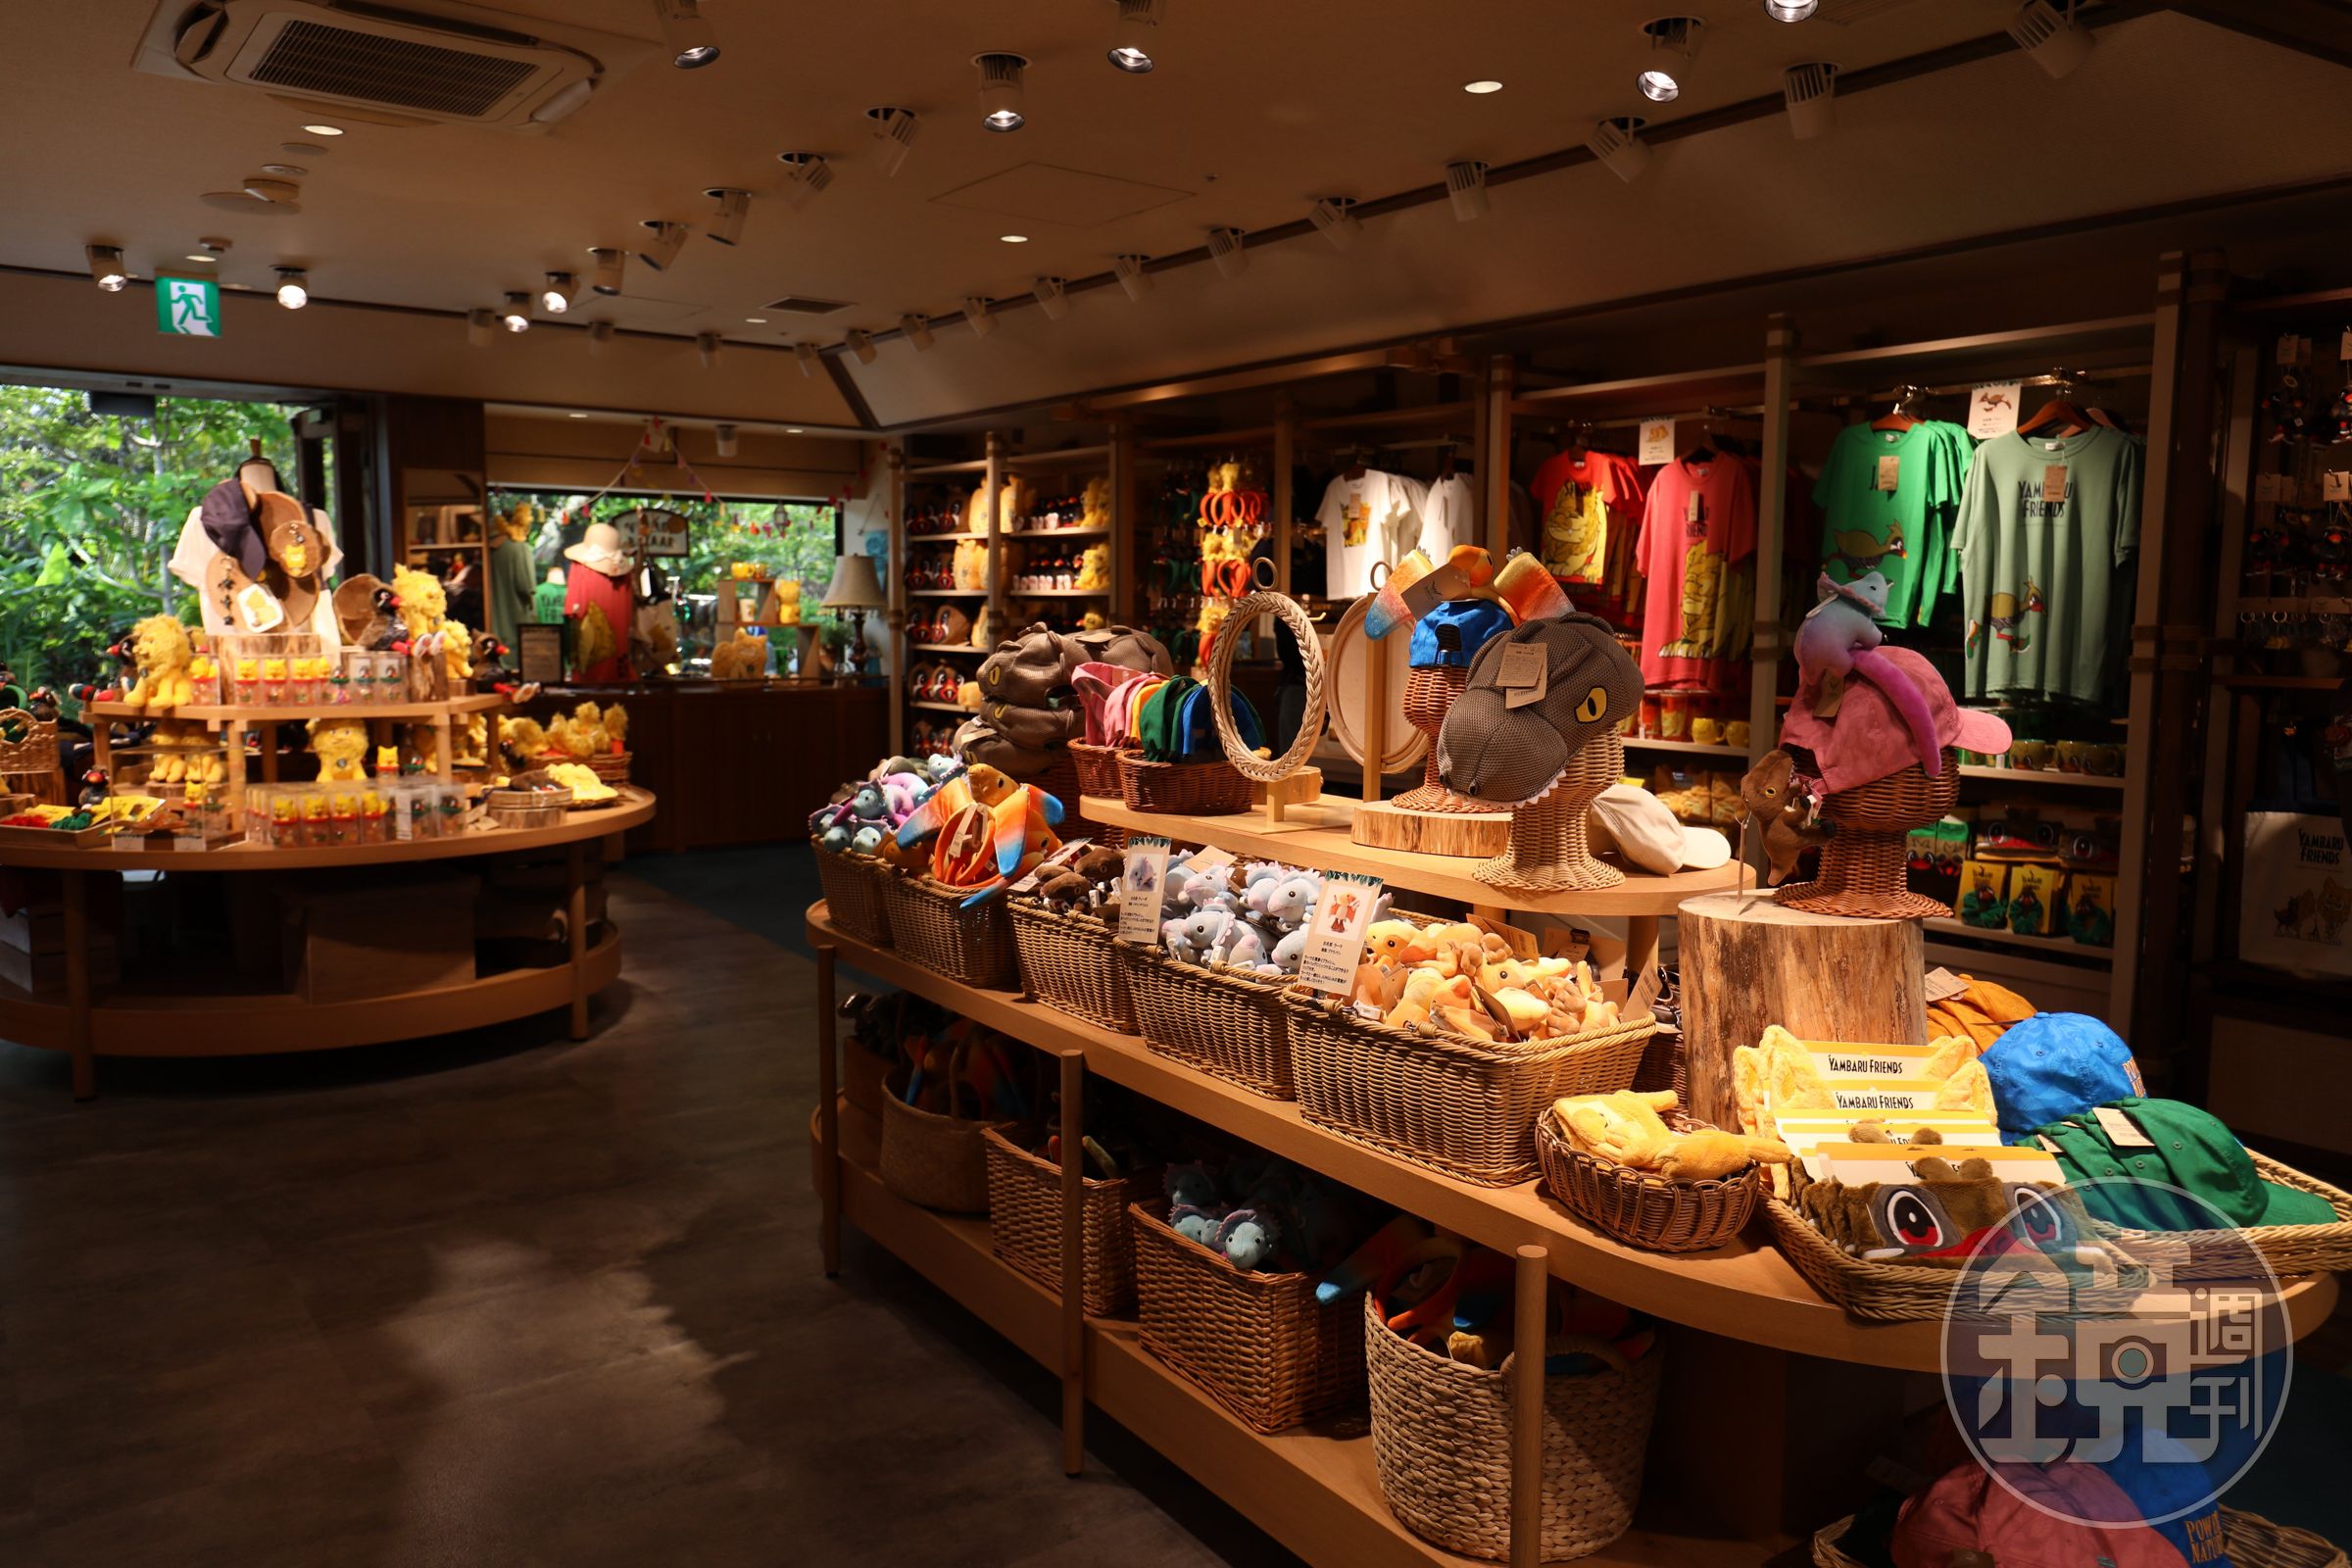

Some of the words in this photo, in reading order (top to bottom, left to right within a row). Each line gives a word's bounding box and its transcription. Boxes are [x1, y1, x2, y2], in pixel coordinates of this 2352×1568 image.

[2018, 480, 2073, 499] YAMU
[2023, 499, 2065, 517] FRIENDS
[2298, 829, 2344, 850] YAMBARU
[2300, 847, 2341, 864] FRIENDS
[1828, 1054, 1868, 1073] YAMBARU
[1869, 1056, 1903, 1074] FRIENDS
[1836, 1092, 1878, 1109] YAMBARU
[1879, 1096, 1914, 1109] FRIENDS
